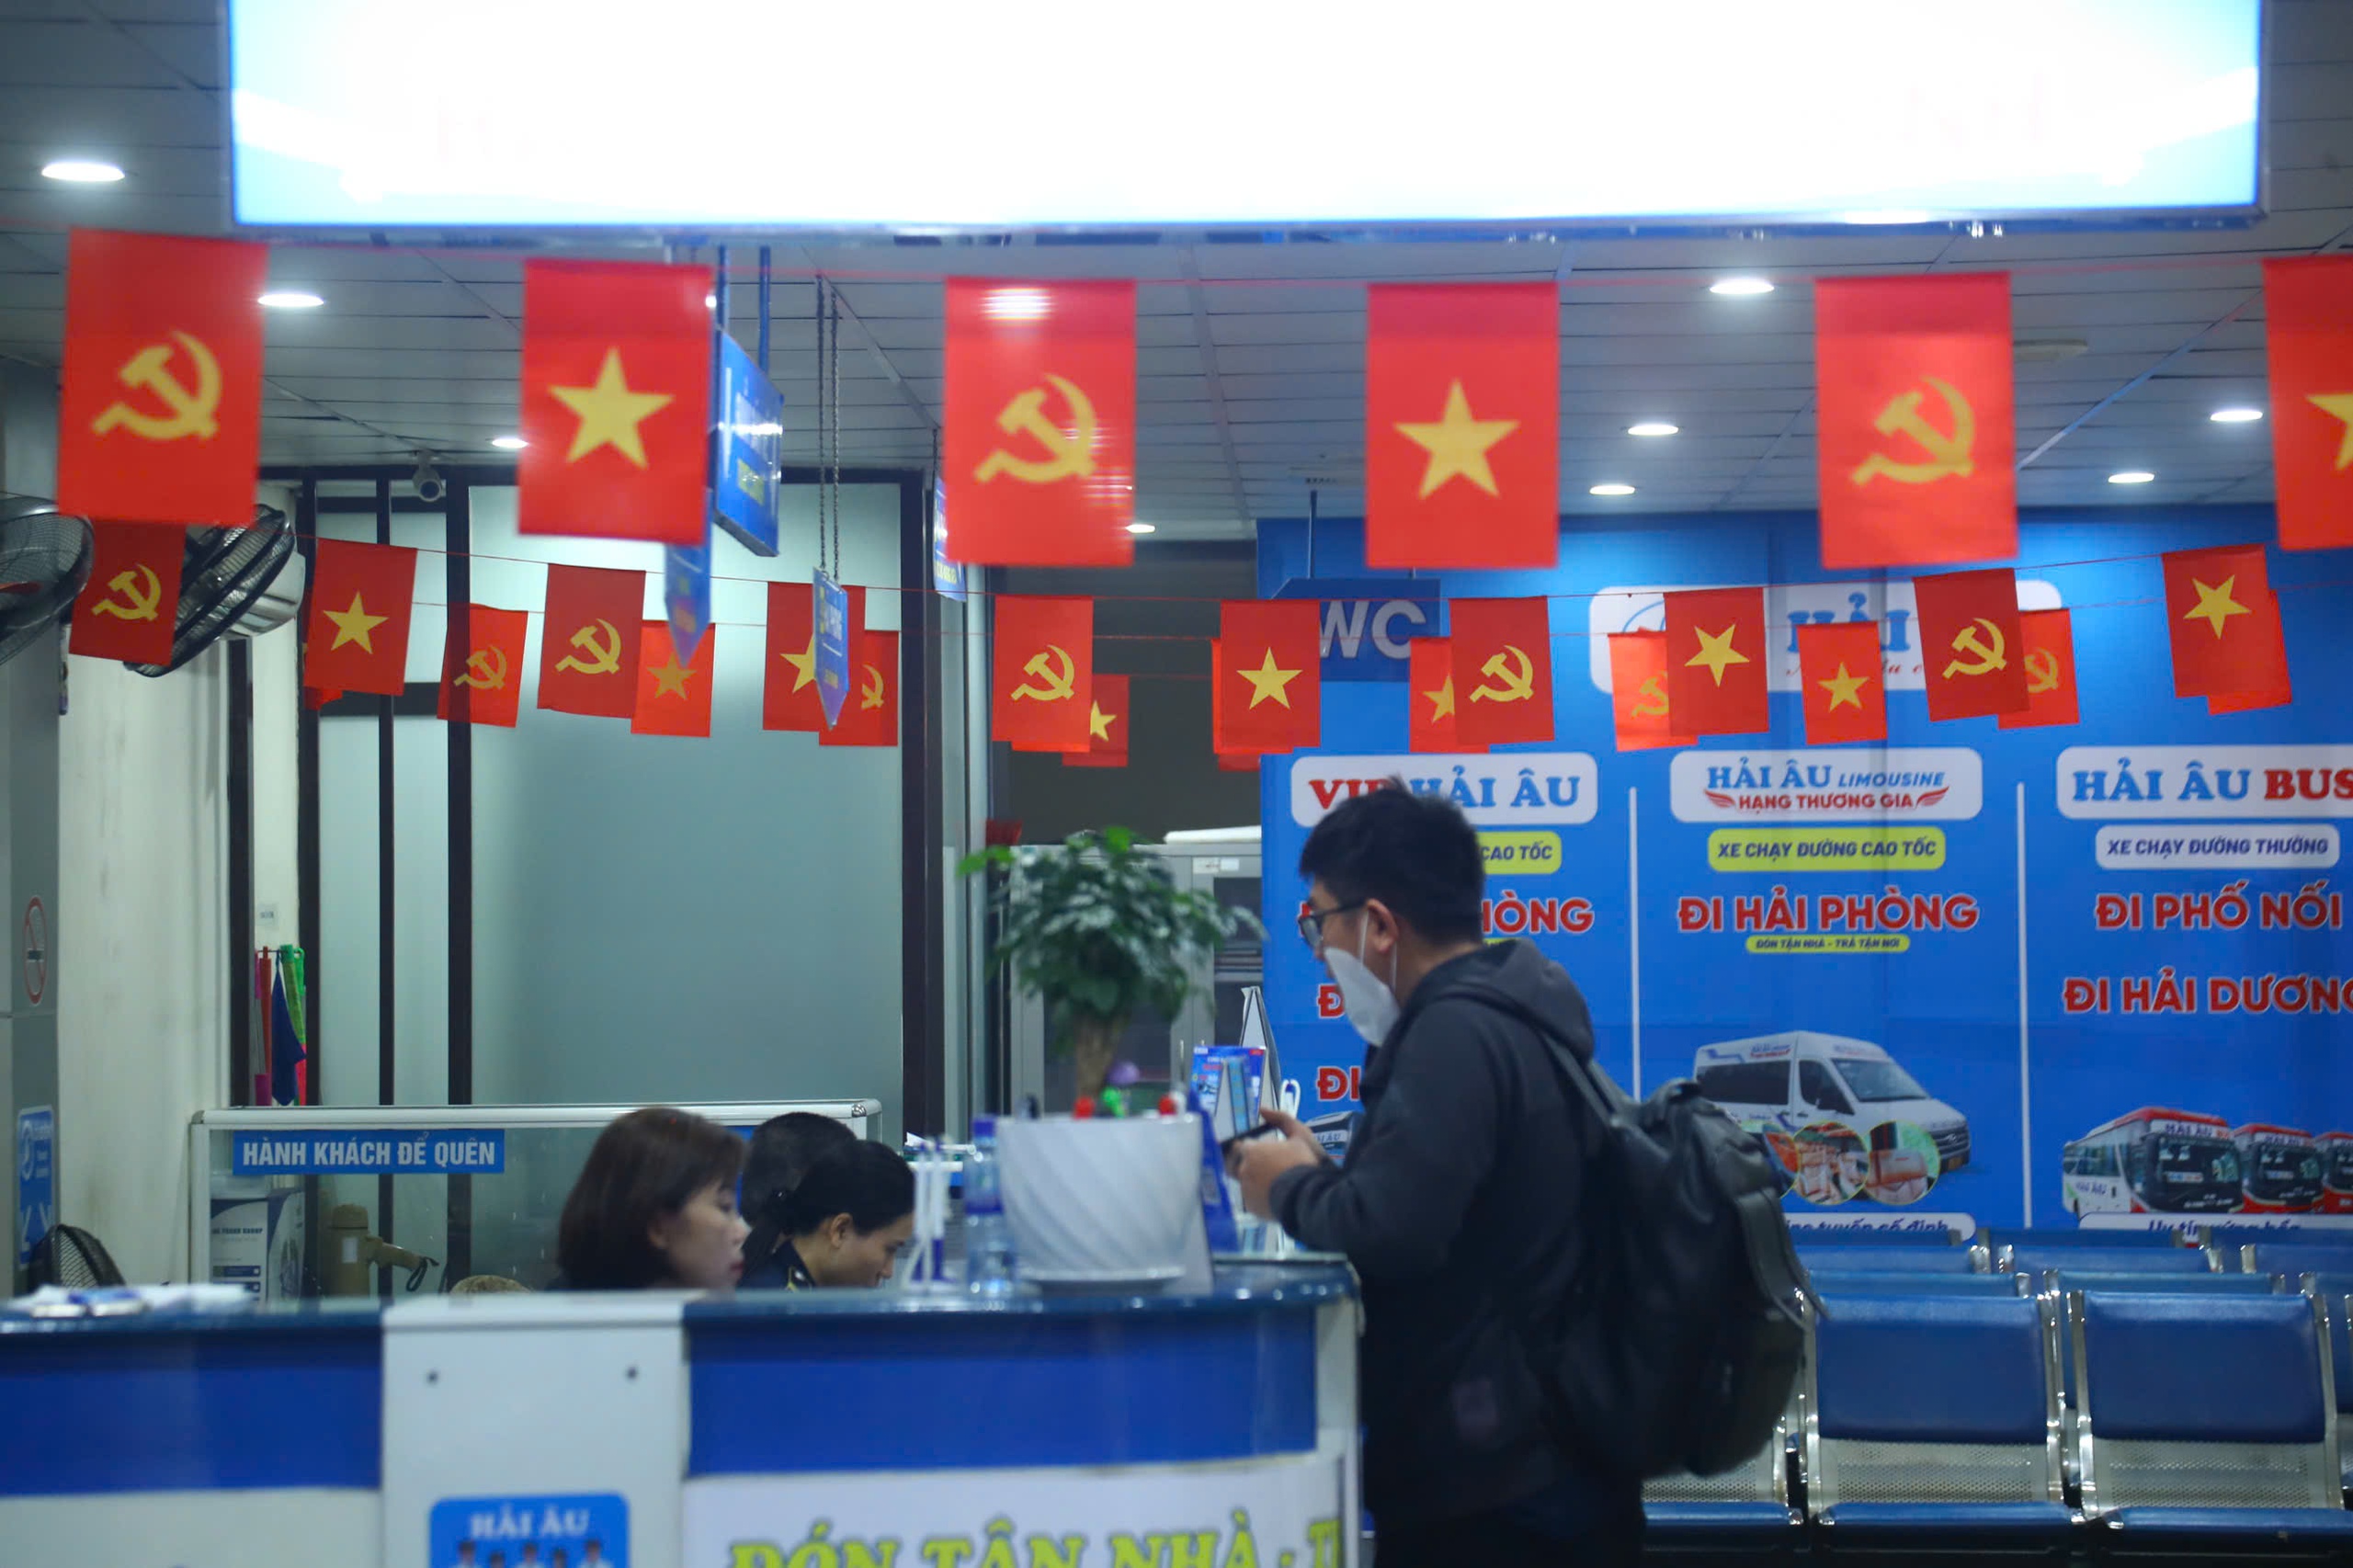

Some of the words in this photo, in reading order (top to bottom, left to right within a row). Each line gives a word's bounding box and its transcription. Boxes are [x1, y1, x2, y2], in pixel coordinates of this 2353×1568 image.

[1320, 599, 1426, 659] WC
[1510, 768, 1580, 807] ÂU
[1708, 756, 1772, 789] HẢI
[1779, 759, 1833, 789] ÂU
[1838, 771, 1946, 787] LIMOUSINE
[2073, 757, 2163, 801] HẢI
[2177, 760, 2251, 801] ÂU
[2264, 768, 2353, 801] BUS
[1739, 795, 1791, 814] HẠNG
[1797, 793, 1876, 809] THƯƠNG
[1881, 793, 1914, 808] GIA
[1481, 846, 1515, 860] CAO
[1519, 840, 1552, 860] TỐC
[1718, 843, 1742, 858] XE
[1745, 842, 1793, 862] CHẠY
[1861, 841, 1898, 857] CAO
[1902, 835, 1937, 857] TỐC
[2108, 840, 2131, 855] XE
[2135, 840, 2185, 859] CHẠY
[1482, 890, 1595, 934] ÒNG
[1677, 896, 1723, 932] ĐI
[1734, 885, 1807, 932] HẢI
[1819, 885, 1979, 932] PHÒNG
[2096, 893, 2142, 929] ĐI
[2154, 880, 2250, 929] PHỐ
[2260, 880, 2343, 929] NỐI
[2063, 977, 2110, 1013] ĐI
[2120, 966, 2197, 1013] HẢI
[1316, 1066, 1362, 1101] ĐI
[243, 1136, 306, 1165] HÀNH
[313, 1136, 391, 1165] KHÁCH
[397, 1131, 429, 1165] ĐỂ
[434, 1136, 495, 1168] QUÊN
